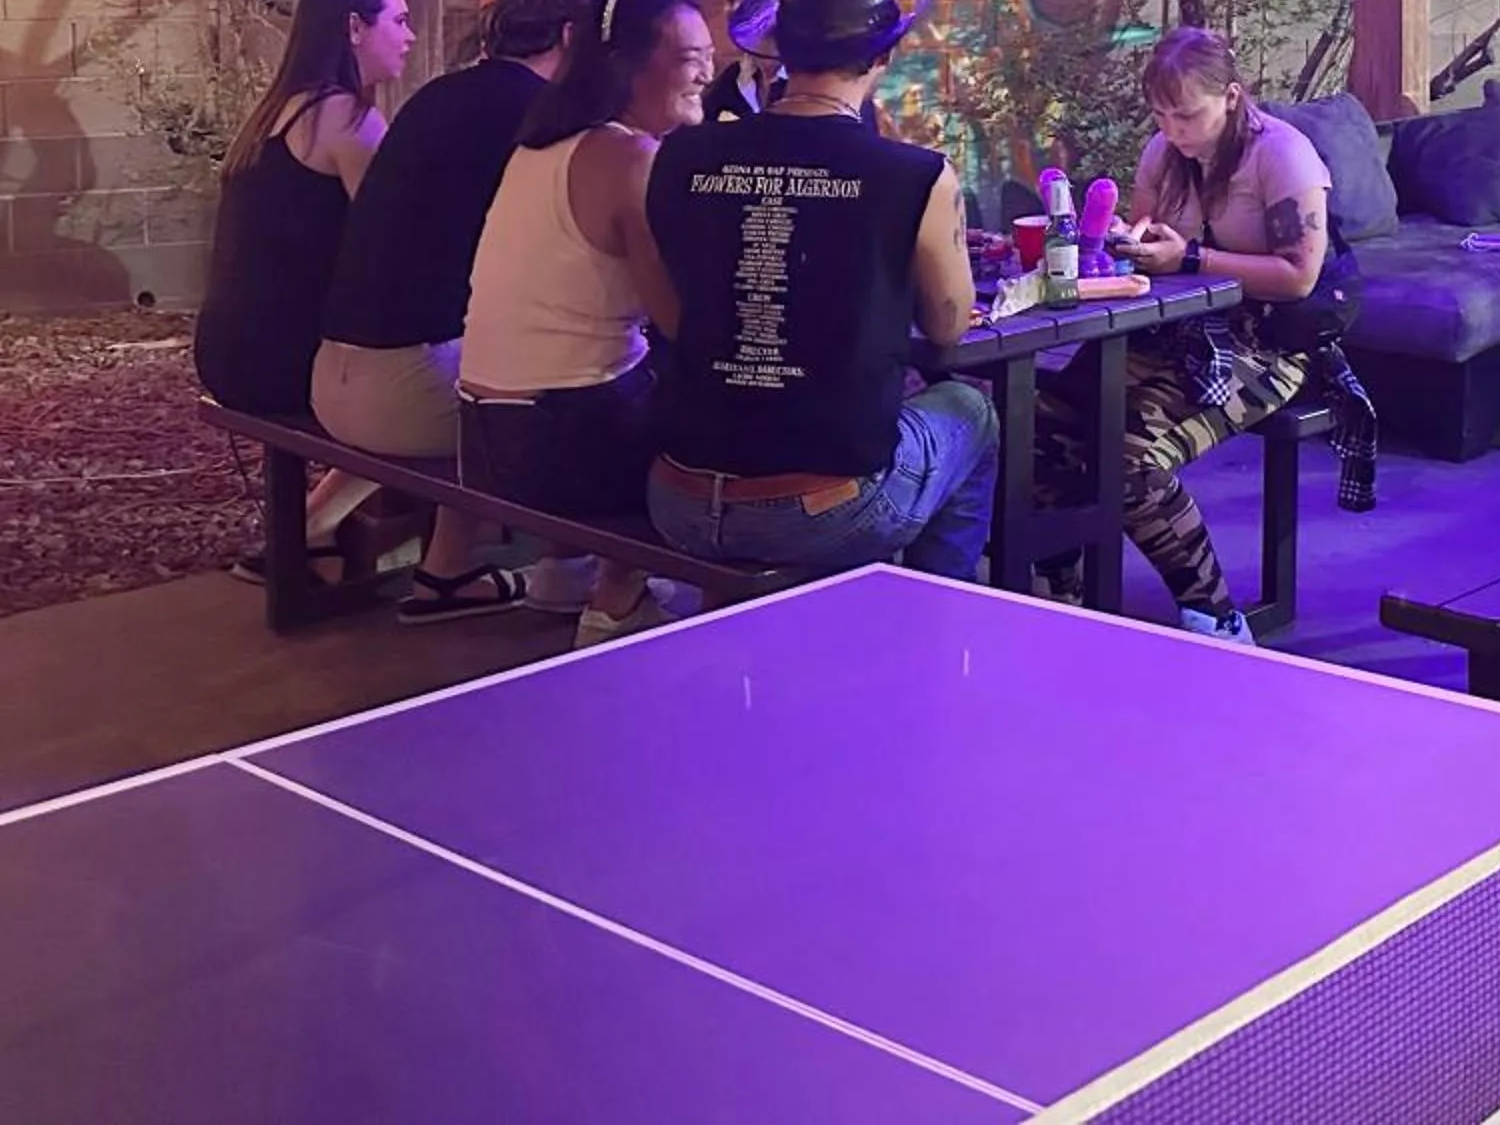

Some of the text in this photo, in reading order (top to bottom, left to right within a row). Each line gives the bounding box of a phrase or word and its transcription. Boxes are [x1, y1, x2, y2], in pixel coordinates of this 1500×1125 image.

[690, 174, 862, 198] FLOWERS FOR ALGERNON
